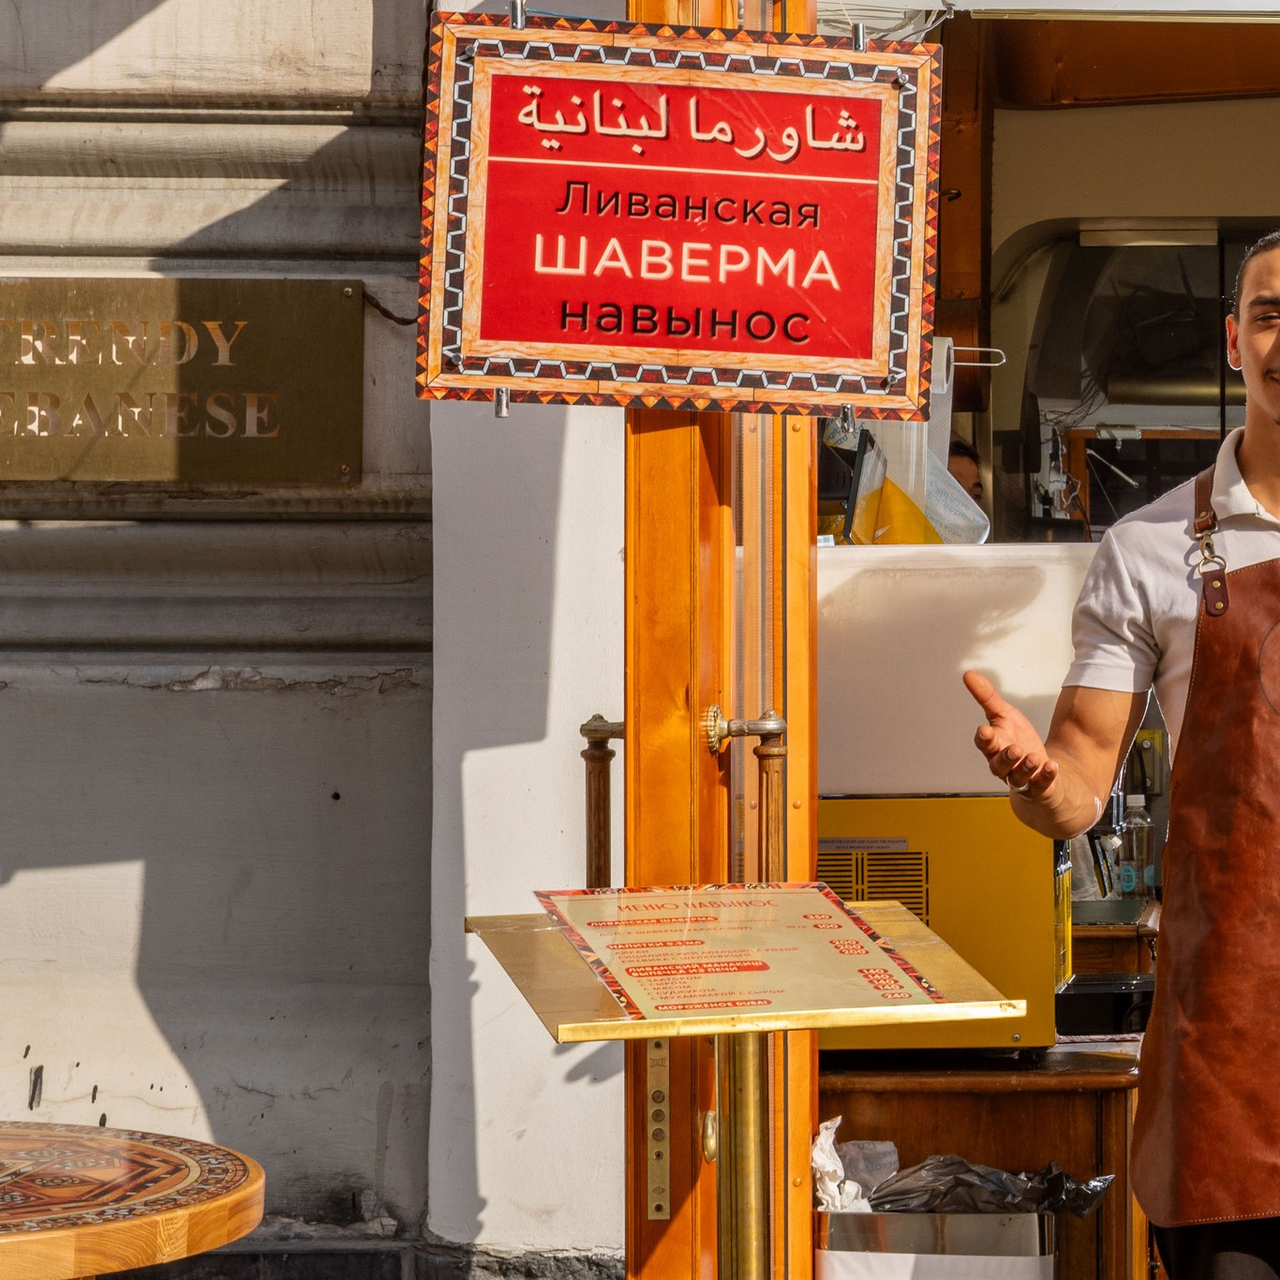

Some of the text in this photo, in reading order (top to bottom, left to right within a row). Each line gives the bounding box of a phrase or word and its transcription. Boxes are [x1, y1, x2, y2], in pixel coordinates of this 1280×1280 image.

[516, 82, 866, 162] شاورما لبنانية
[556, 180, 821, 229] Ливанская
[533, 232, 840, 291] ШАВЕРМА
[559, 300, 811, 344] навынос
[618, 899, 778, 912] МЕНЮ НАВЫНОС
[590, 919, 657, 927] ЛИВАНСКАЯ
[629, 964, 700, 972] ЛИВАНСКИЙ
[658, 1001, 733, 1010] МОРОЖЕНОЕ
